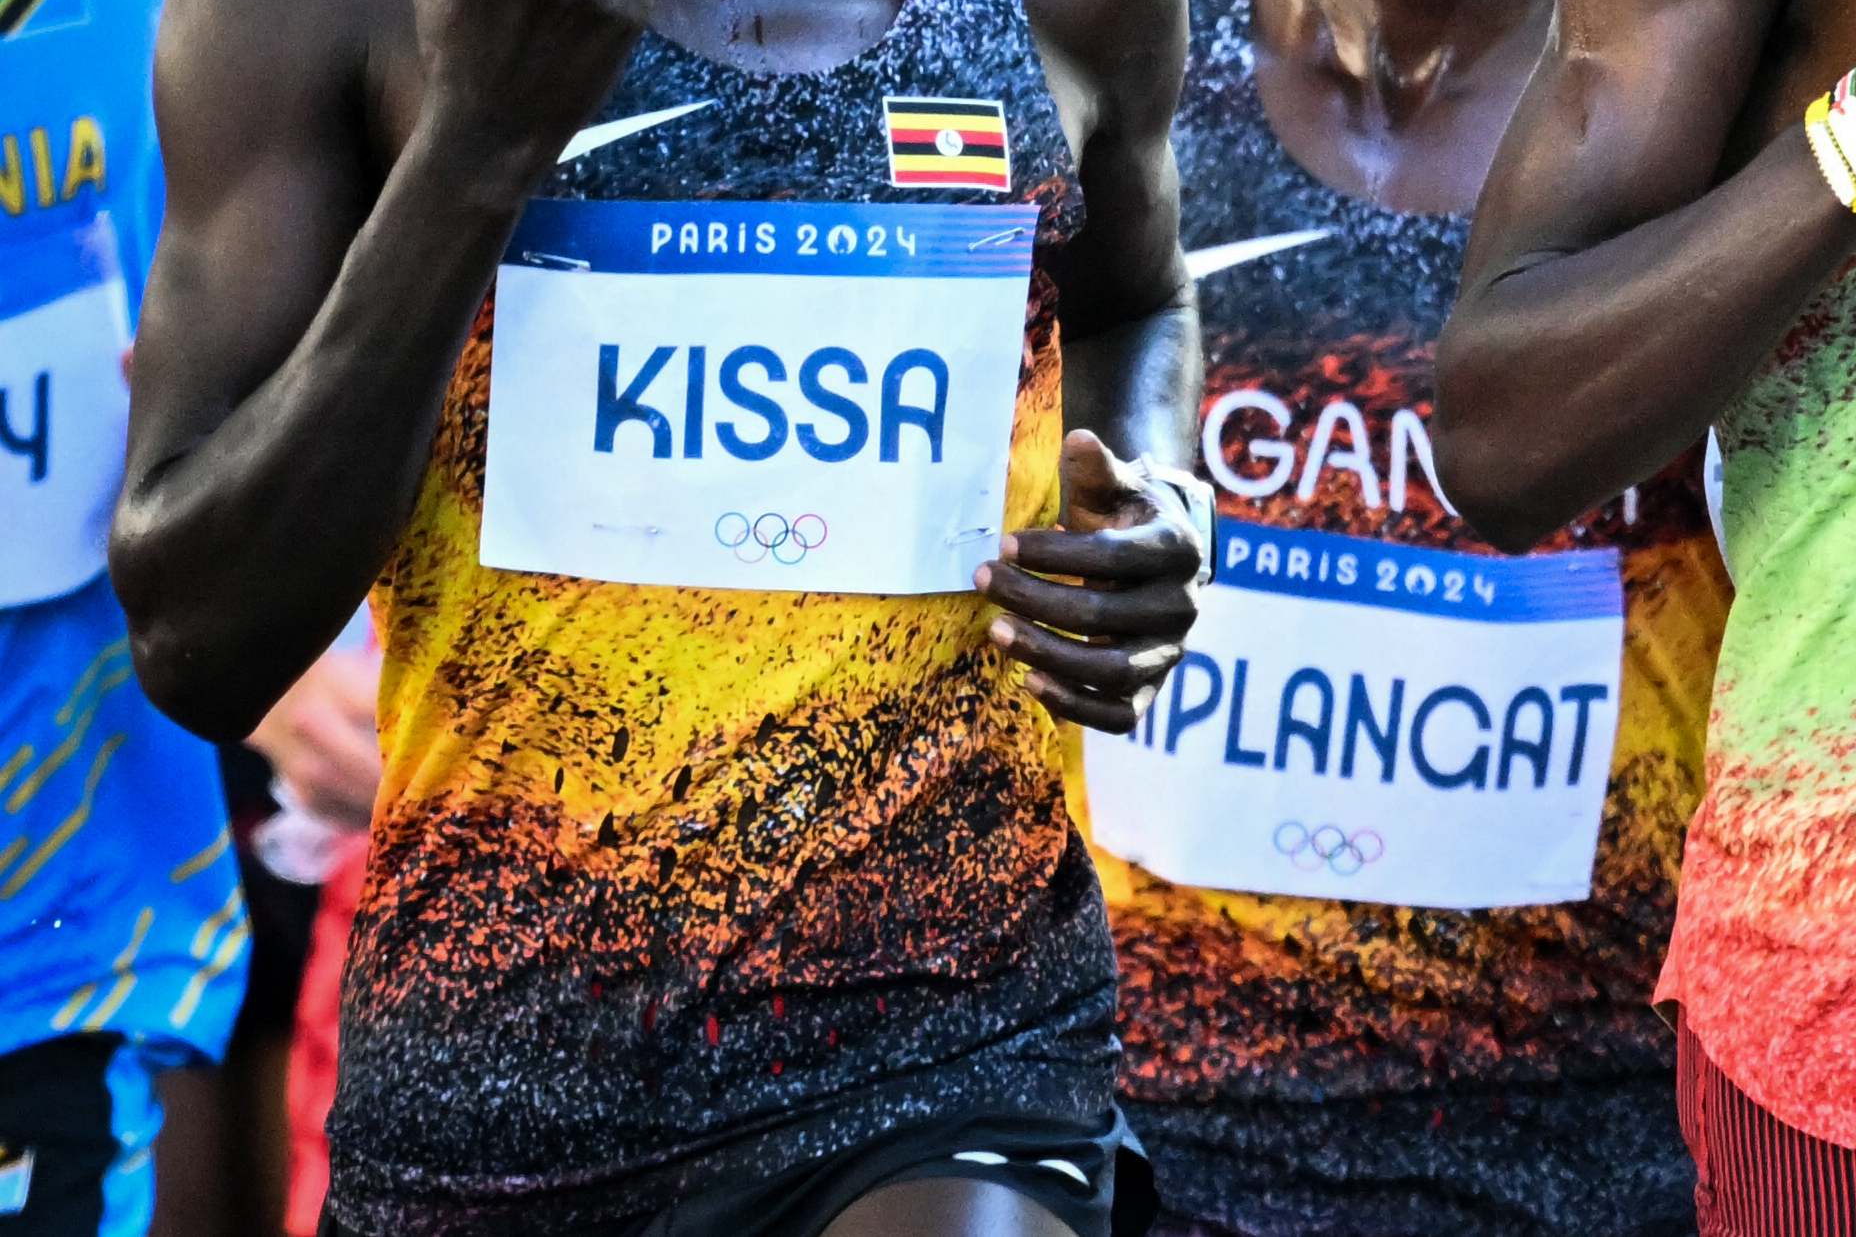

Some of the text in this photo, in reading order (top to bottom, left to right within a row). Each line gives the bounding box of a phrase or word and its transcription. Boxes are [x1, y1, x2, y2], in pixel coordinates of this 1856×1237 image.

[797, 223, 917, 257] 2024
[593, 343, 950, 463] KISSA
[1375, 558, 1497, 606] 2024
[1127, 649, 1609, 792] PLANGAT
